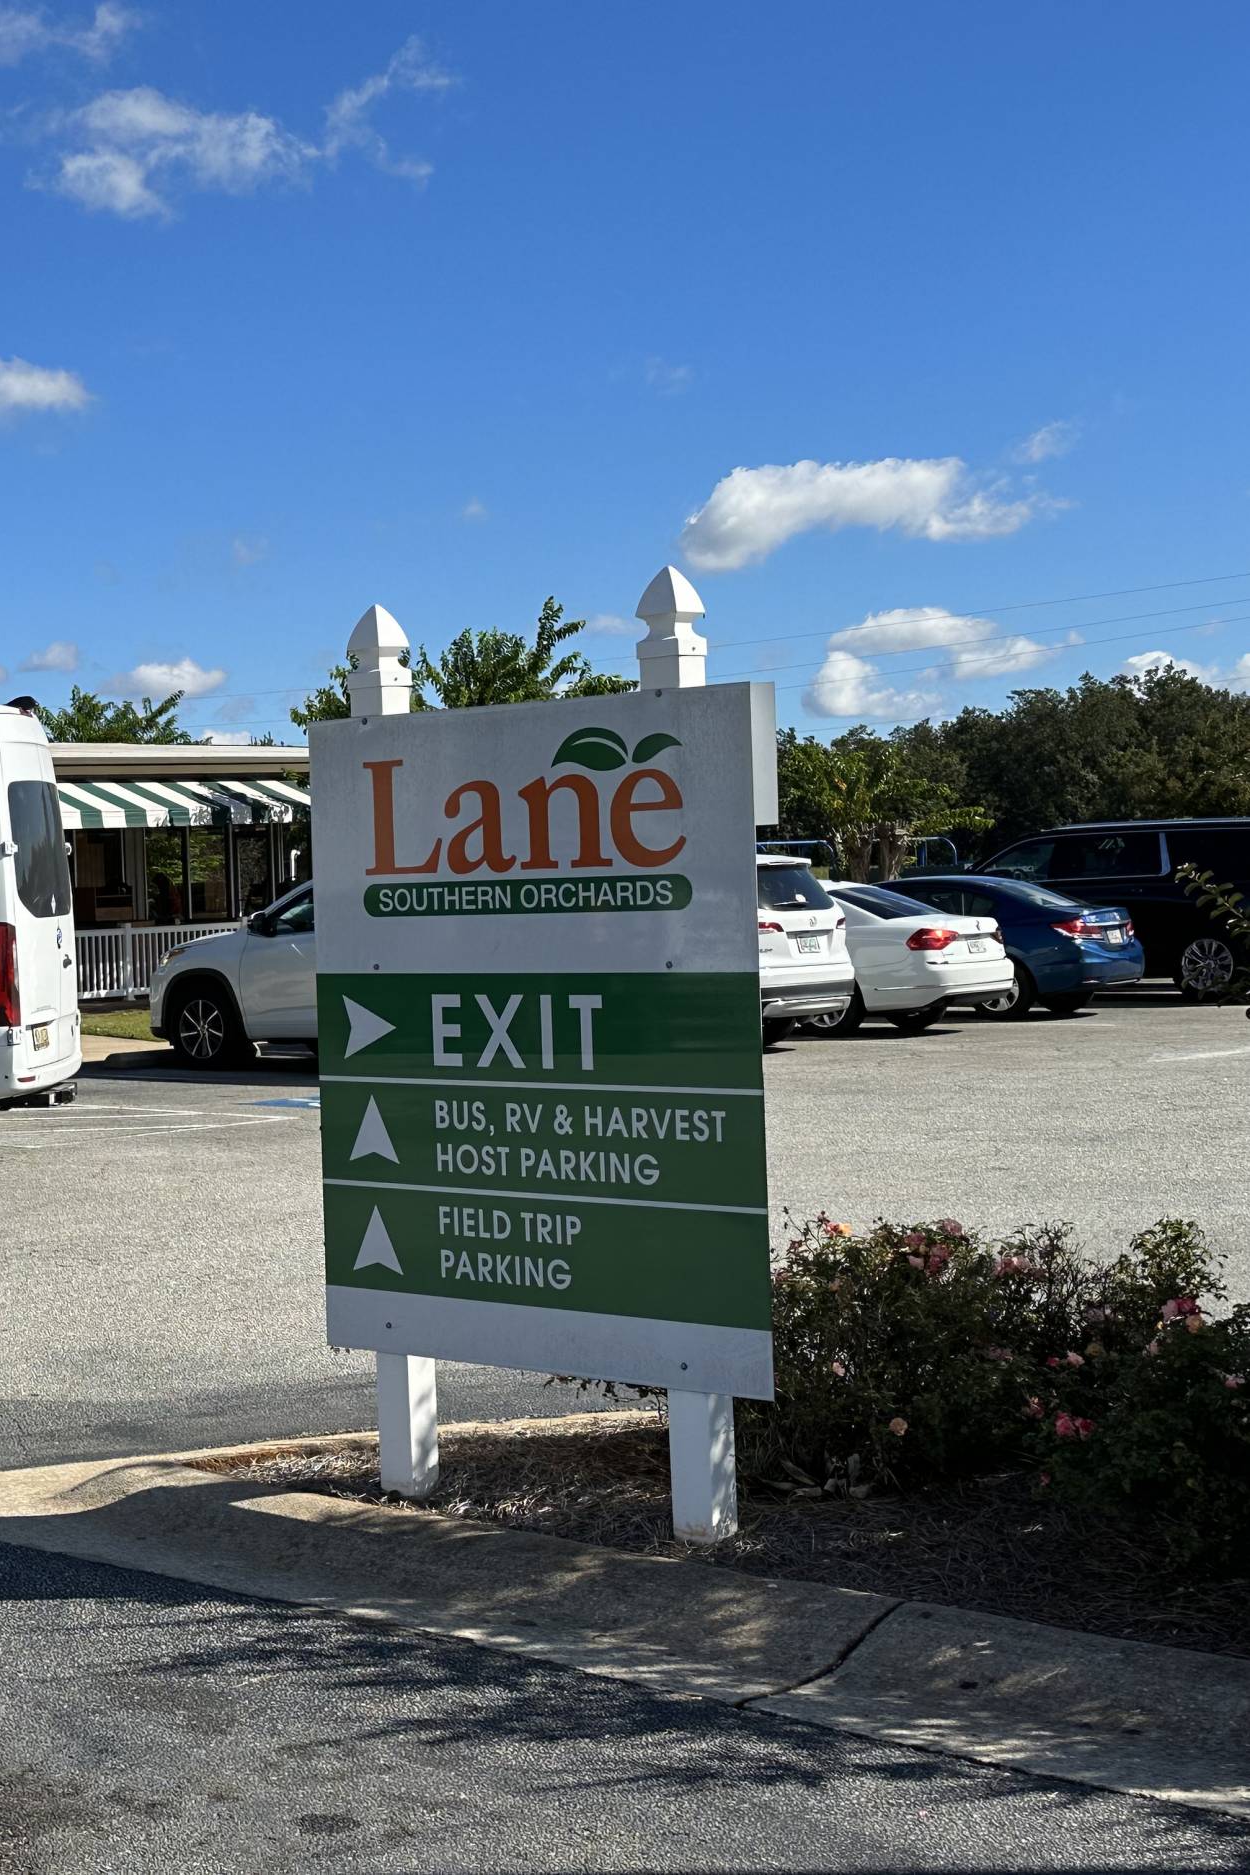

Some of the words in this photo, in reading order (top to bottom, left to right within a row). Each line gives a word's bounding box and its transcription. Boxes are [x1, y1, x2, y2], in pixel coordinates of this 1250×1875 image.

[362, 759, 687, 876] Lane
[379, 885, 512, 912] SOUTHERN
[520, 880, 674, 908] ORCHARDS
[431, 993, 603, 1071] EXIT
[435, 1100, 495, 1136] BUS,
[505, 1102, 543, 1133] RV
[554, 1104, 574, 1135] &
[584, 1105, 726, 1142] HARVEST
[436, 1142, 510, 1176] HOST
[520, 1147, 660, 1186] PARKING
[438, 1205, 511, 1240] FIELD
[520, 1212, 582, 1246] TRIP
[440, 1248, 572, 1290] PARKING
